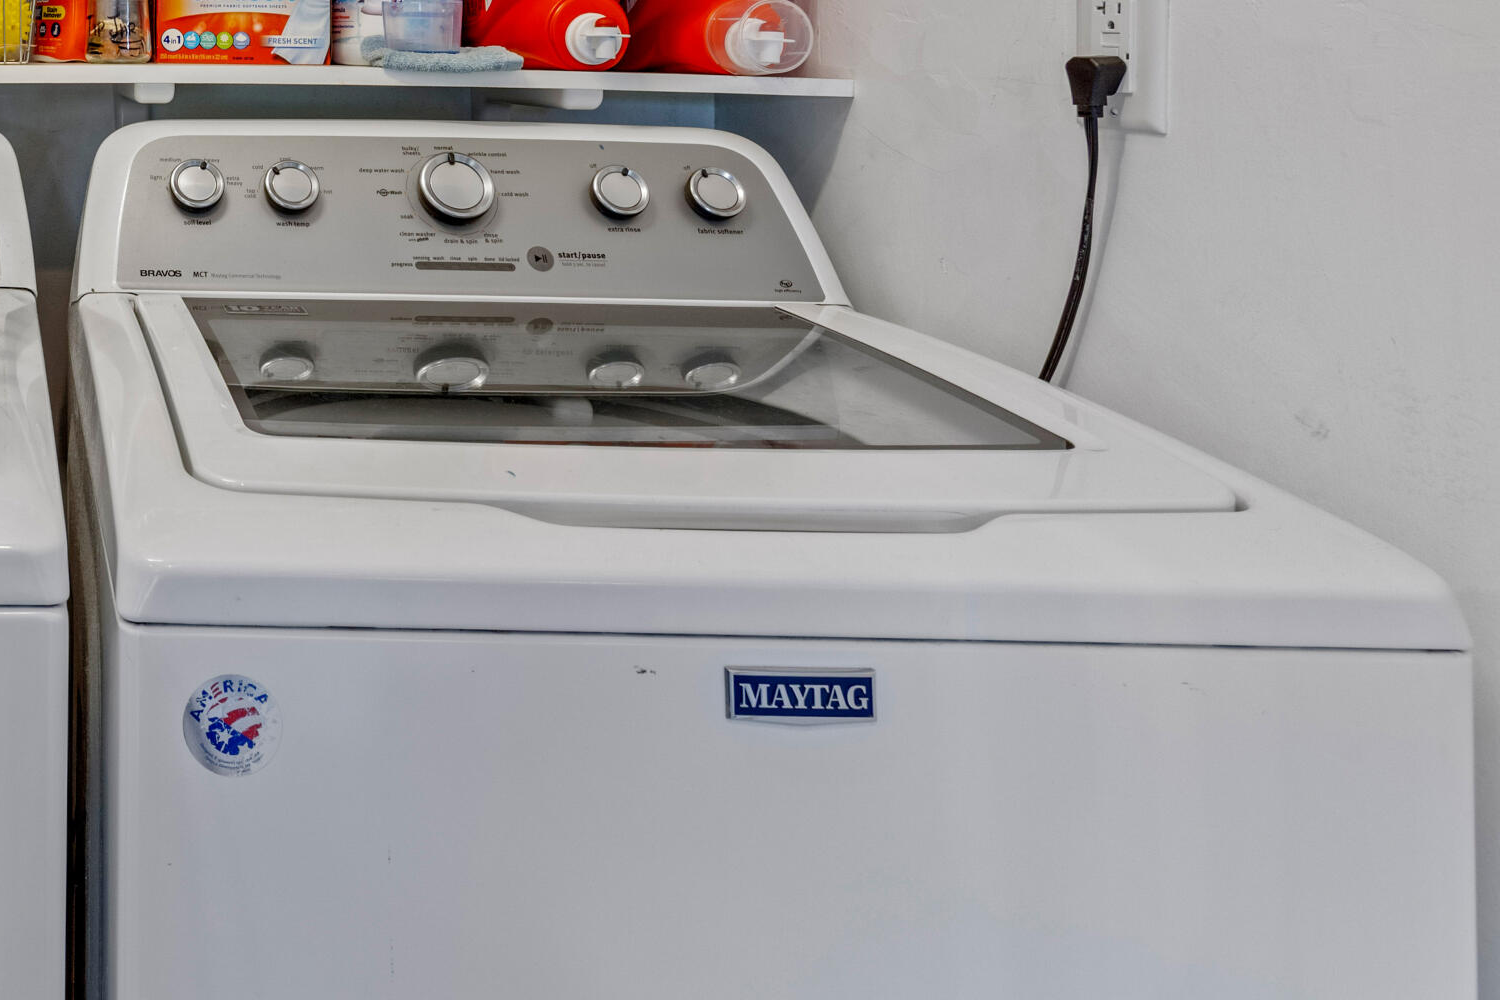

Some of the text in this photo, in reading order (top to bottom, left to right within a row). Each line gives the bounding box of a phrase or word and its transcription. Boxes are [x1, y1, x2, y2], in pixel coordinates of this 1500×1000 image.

[43, 11, 62, 19] Remover
[267, 37, 318, 45] FRESH SCENT
[196, 218, 212, 226] level
[293, 220, 311, 229] temp
[697, 227, 744, 236] fabric softener
[465, 238, 479, 246] spin
[557, 251, 607, 261] start/pause
[139, 269, 182, 278] BRAVOS
[738, 682, 869, 710] MAYTAG
[189, 679, 269, 723] AMERICA
